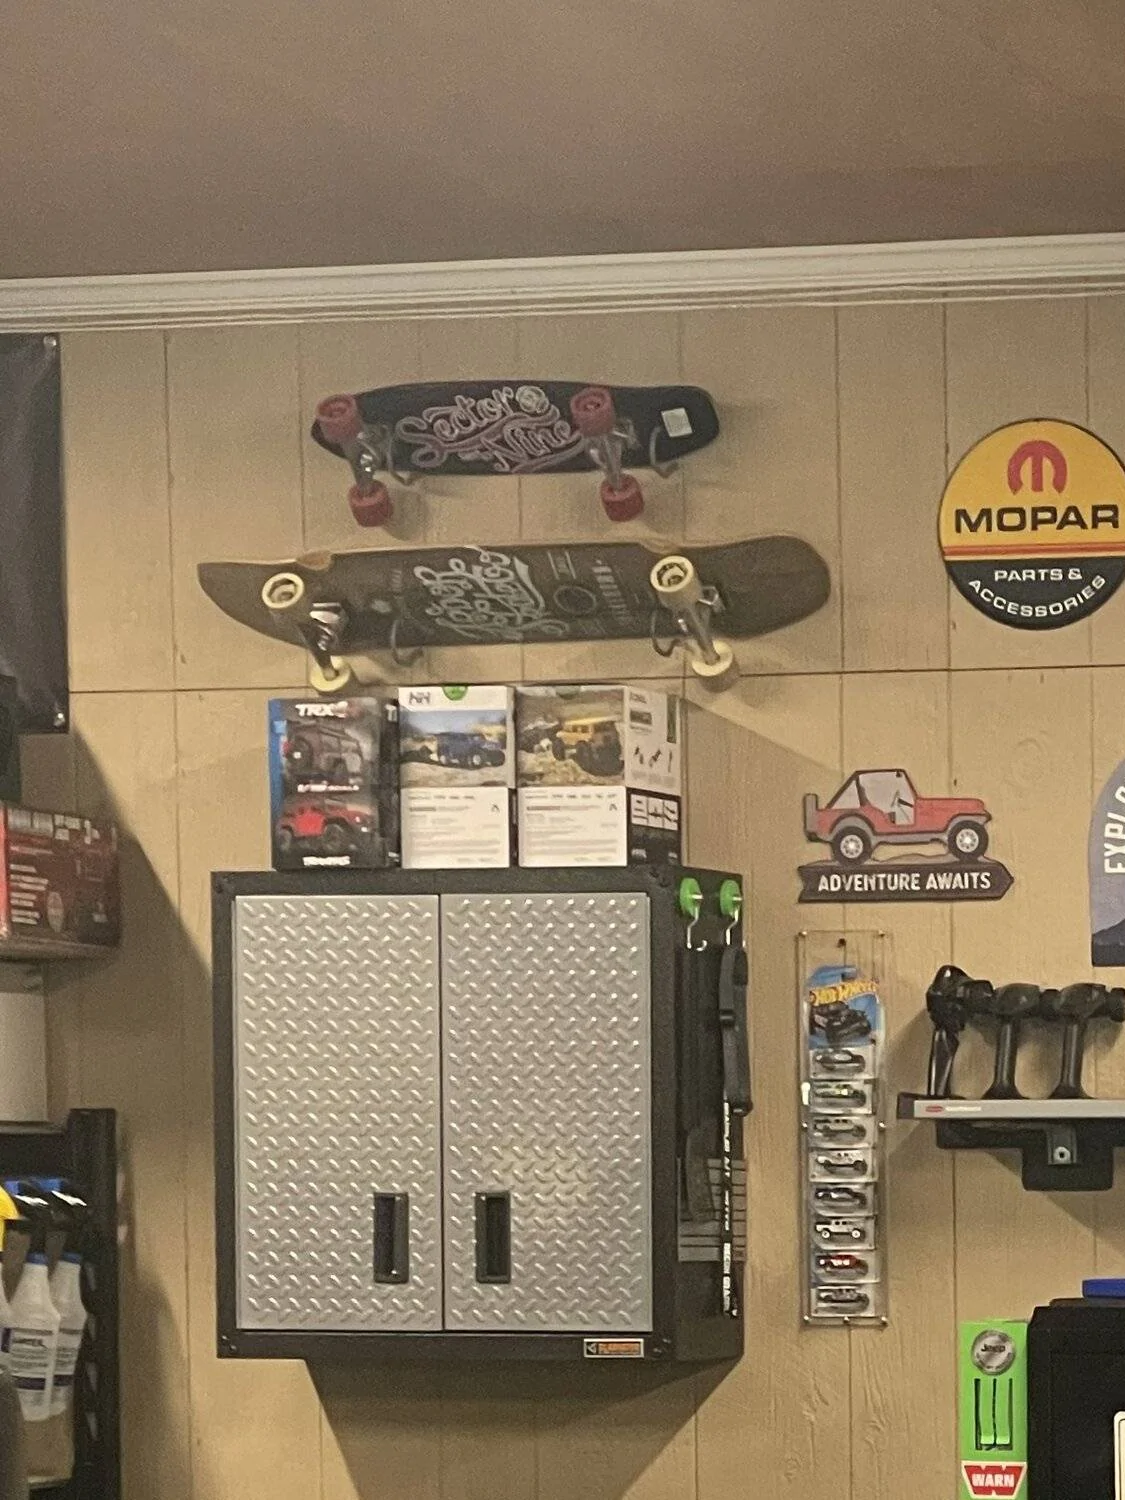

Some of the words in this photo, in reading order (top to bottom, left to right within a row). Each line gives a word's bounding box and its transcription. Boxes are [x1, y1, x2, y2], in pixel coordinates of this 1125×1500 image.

[955, 504, 1119, 533] MOPAR
[994, 568, 1063, 582] PARTS
[1068, 567, 1082, 580] &
[968, 574, 1106, 617] ACCESSORIES
[818, 873, 921, 892] ADVENTURE
[926, 872, 992, 891] AWAITS
[971, 1473, 1015, 1488] WARN
